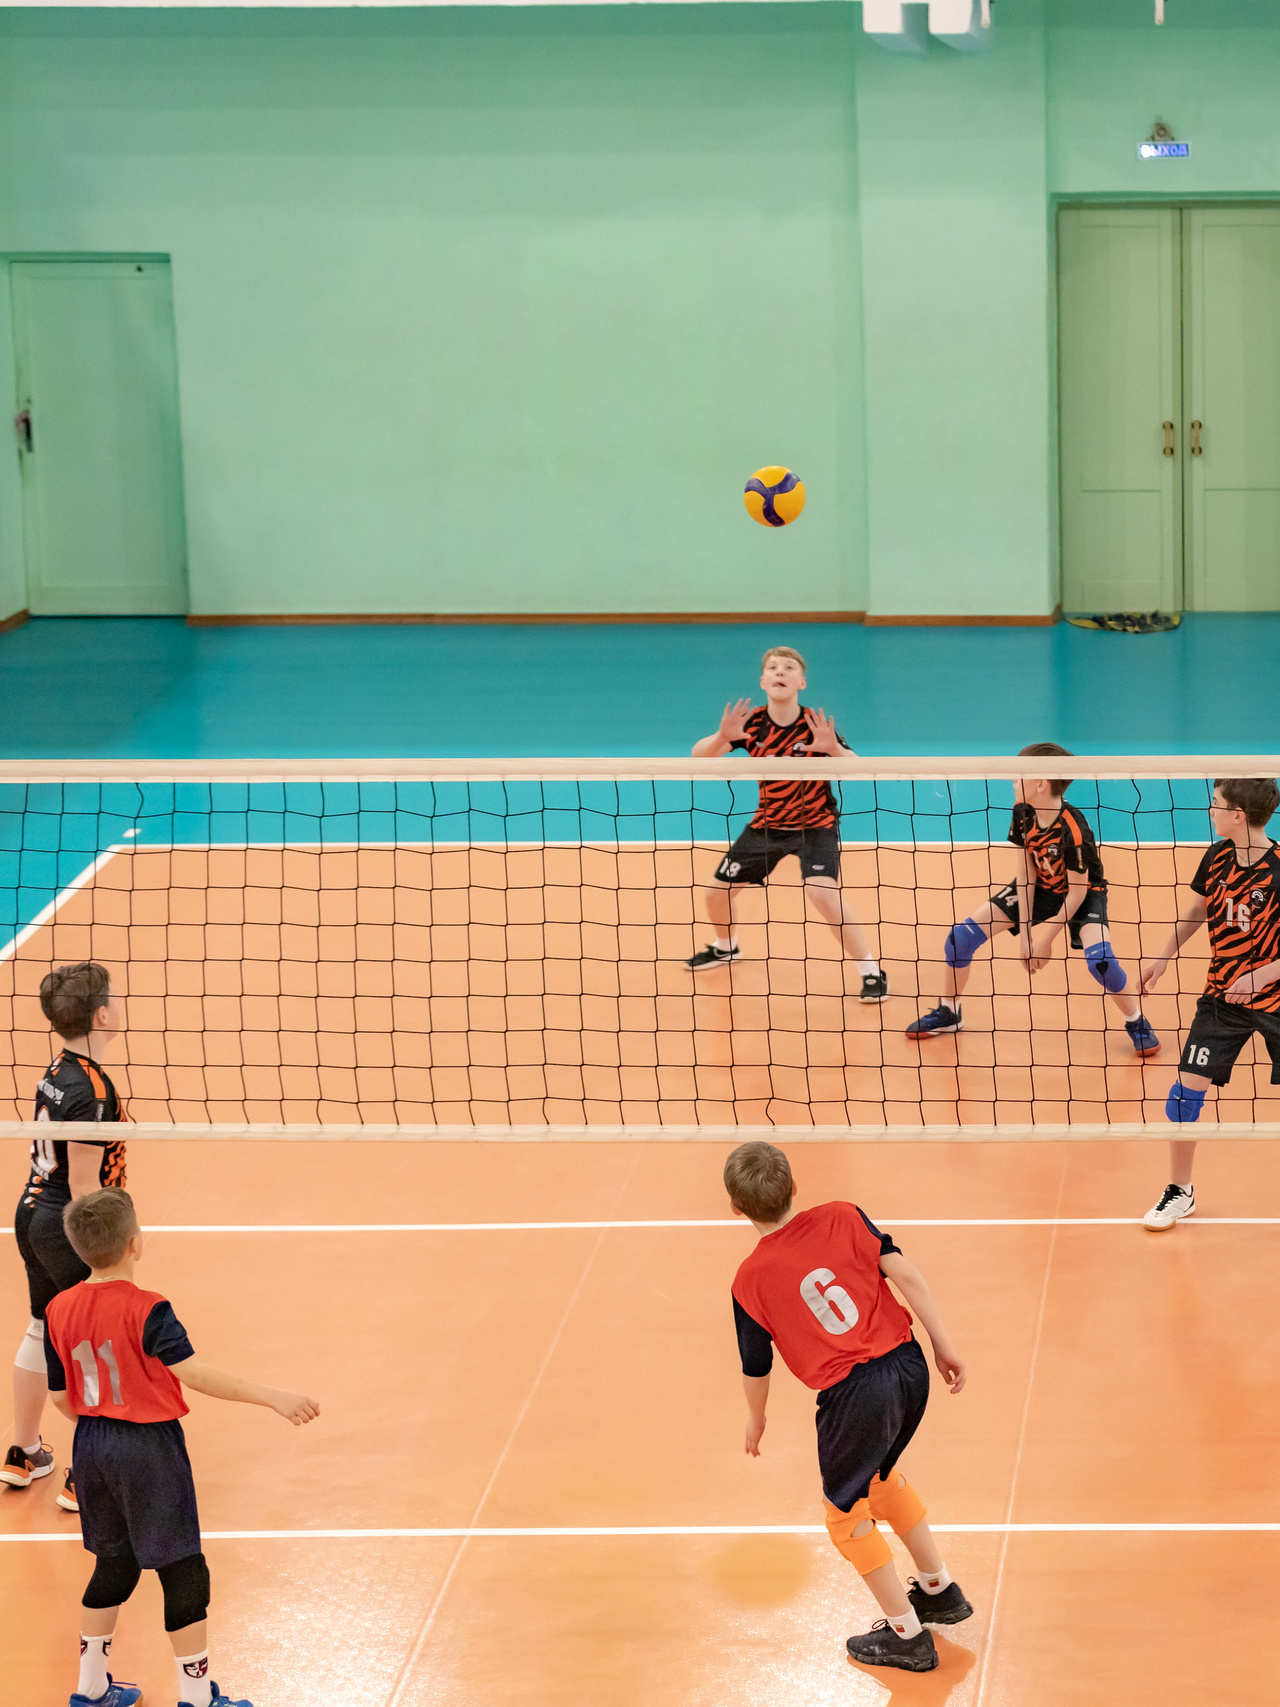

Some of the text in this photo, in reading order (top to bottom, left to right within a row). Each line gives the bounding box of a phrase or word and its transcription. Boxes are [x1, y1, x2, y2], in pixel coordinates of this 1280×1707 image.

[1141, 144, 1188, 158] ВЫХОД
[1225, 897, 1251, 933] 16
[1187, 1044, 1210, 1066] 16
[799, 1267, 860, 1336] 6
[71, 1339, 125, 1407] 11
